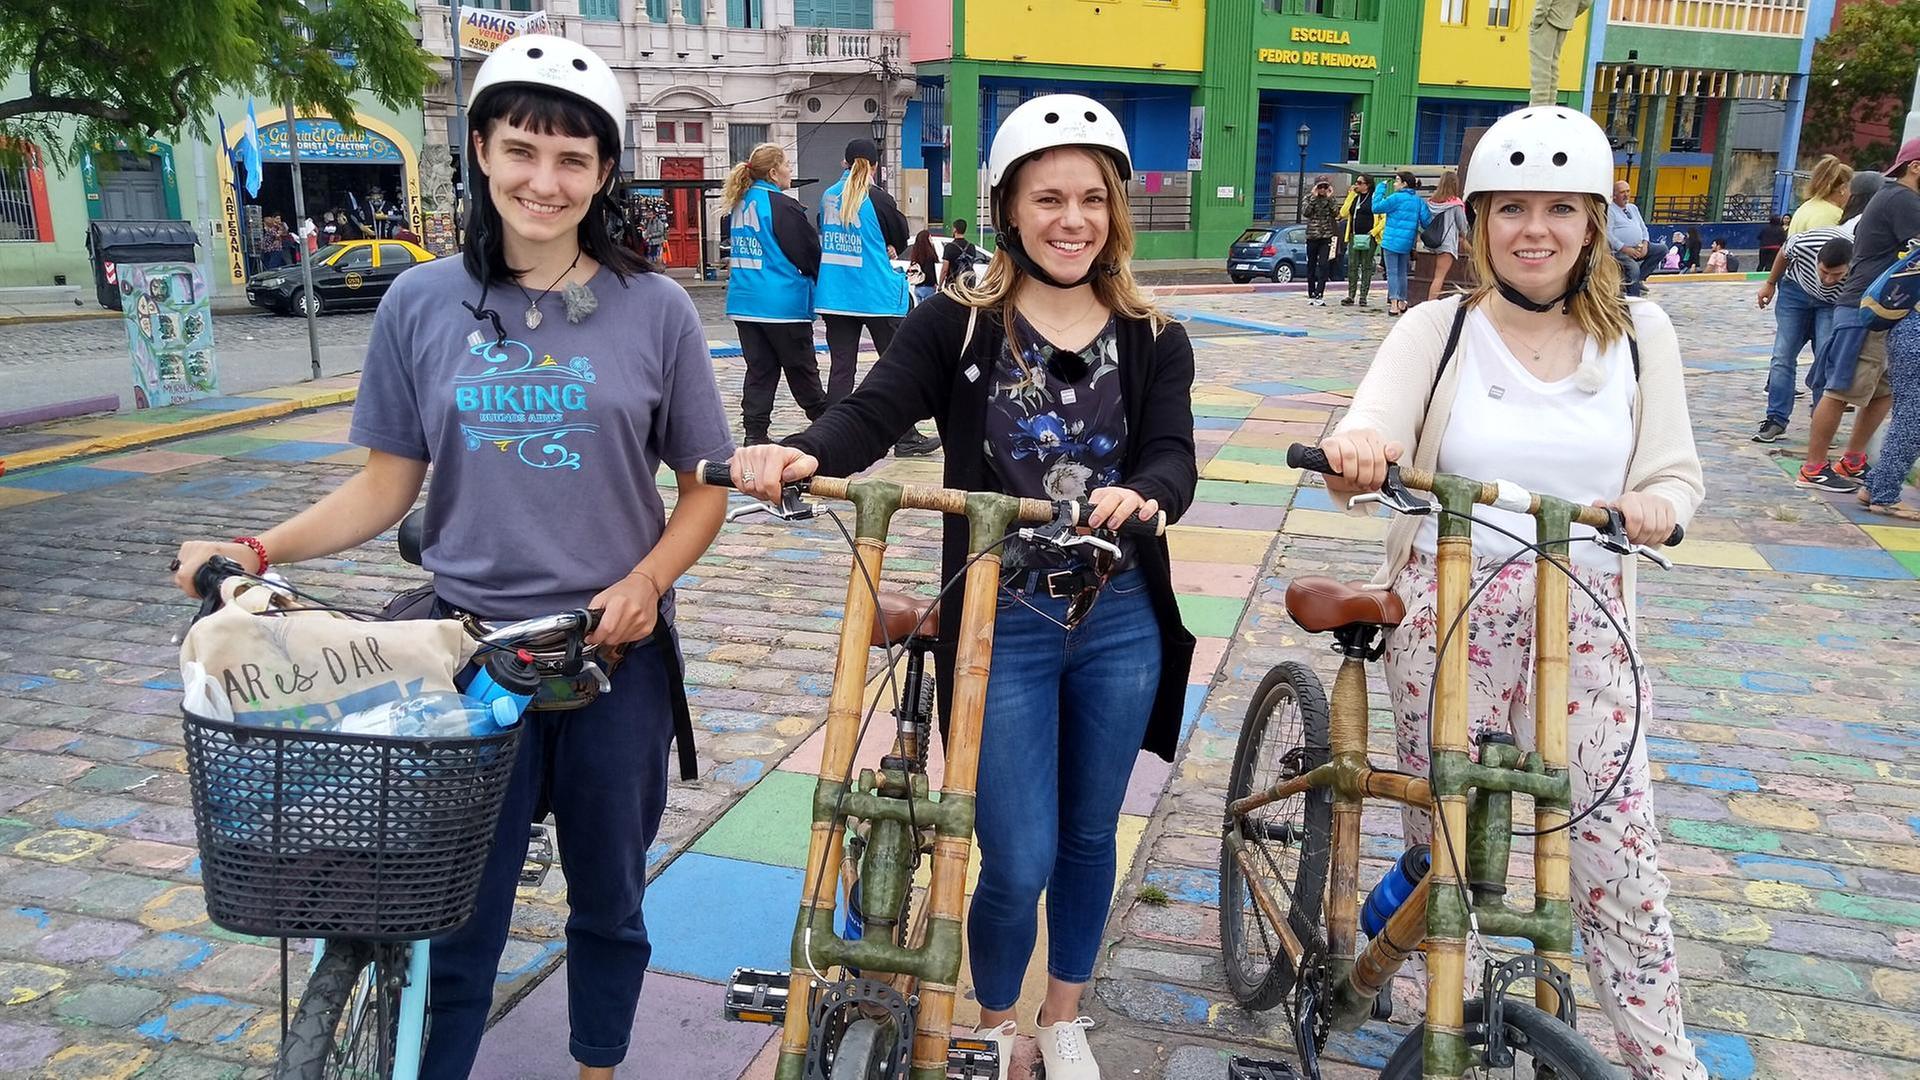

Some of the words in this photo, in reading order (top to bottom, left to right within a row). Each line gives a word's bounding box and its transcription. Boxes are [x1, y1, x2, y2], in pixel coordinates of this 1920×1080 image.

[467, 12, 516, 36] ARKIS
[469, 37, 489, 48] 4300
[478, 29, 510, 42] vende
[1291, 27, 1350, 44] ESCUELA
[1258, 48, 1300, 64] PEDRO
[1302, 50, 1319, 65] DE
[1320, 52, 1377, 69] MENDOZA
[1598, 65, 1673, 96] TEATRO
[1679, 69, 1703, 97] DE
[1708, 71, 1729, 98] LA
[269, 127, 311, 143] Garia
[281, 142, 328, 151] MORISTA
[336, 144, 370, 152] FACTORY
[226, 196, 243, 279] ARTESANIAS
[824, 242, 834, 251] LA
[836, 243, 862, 254] CIUDAD
[455, 383, 589, 413] BIKING
[480, 412, 526, 423] BUENOS
[275, 663, 319, 695] es
[321, 636, 394, 685] DAR
